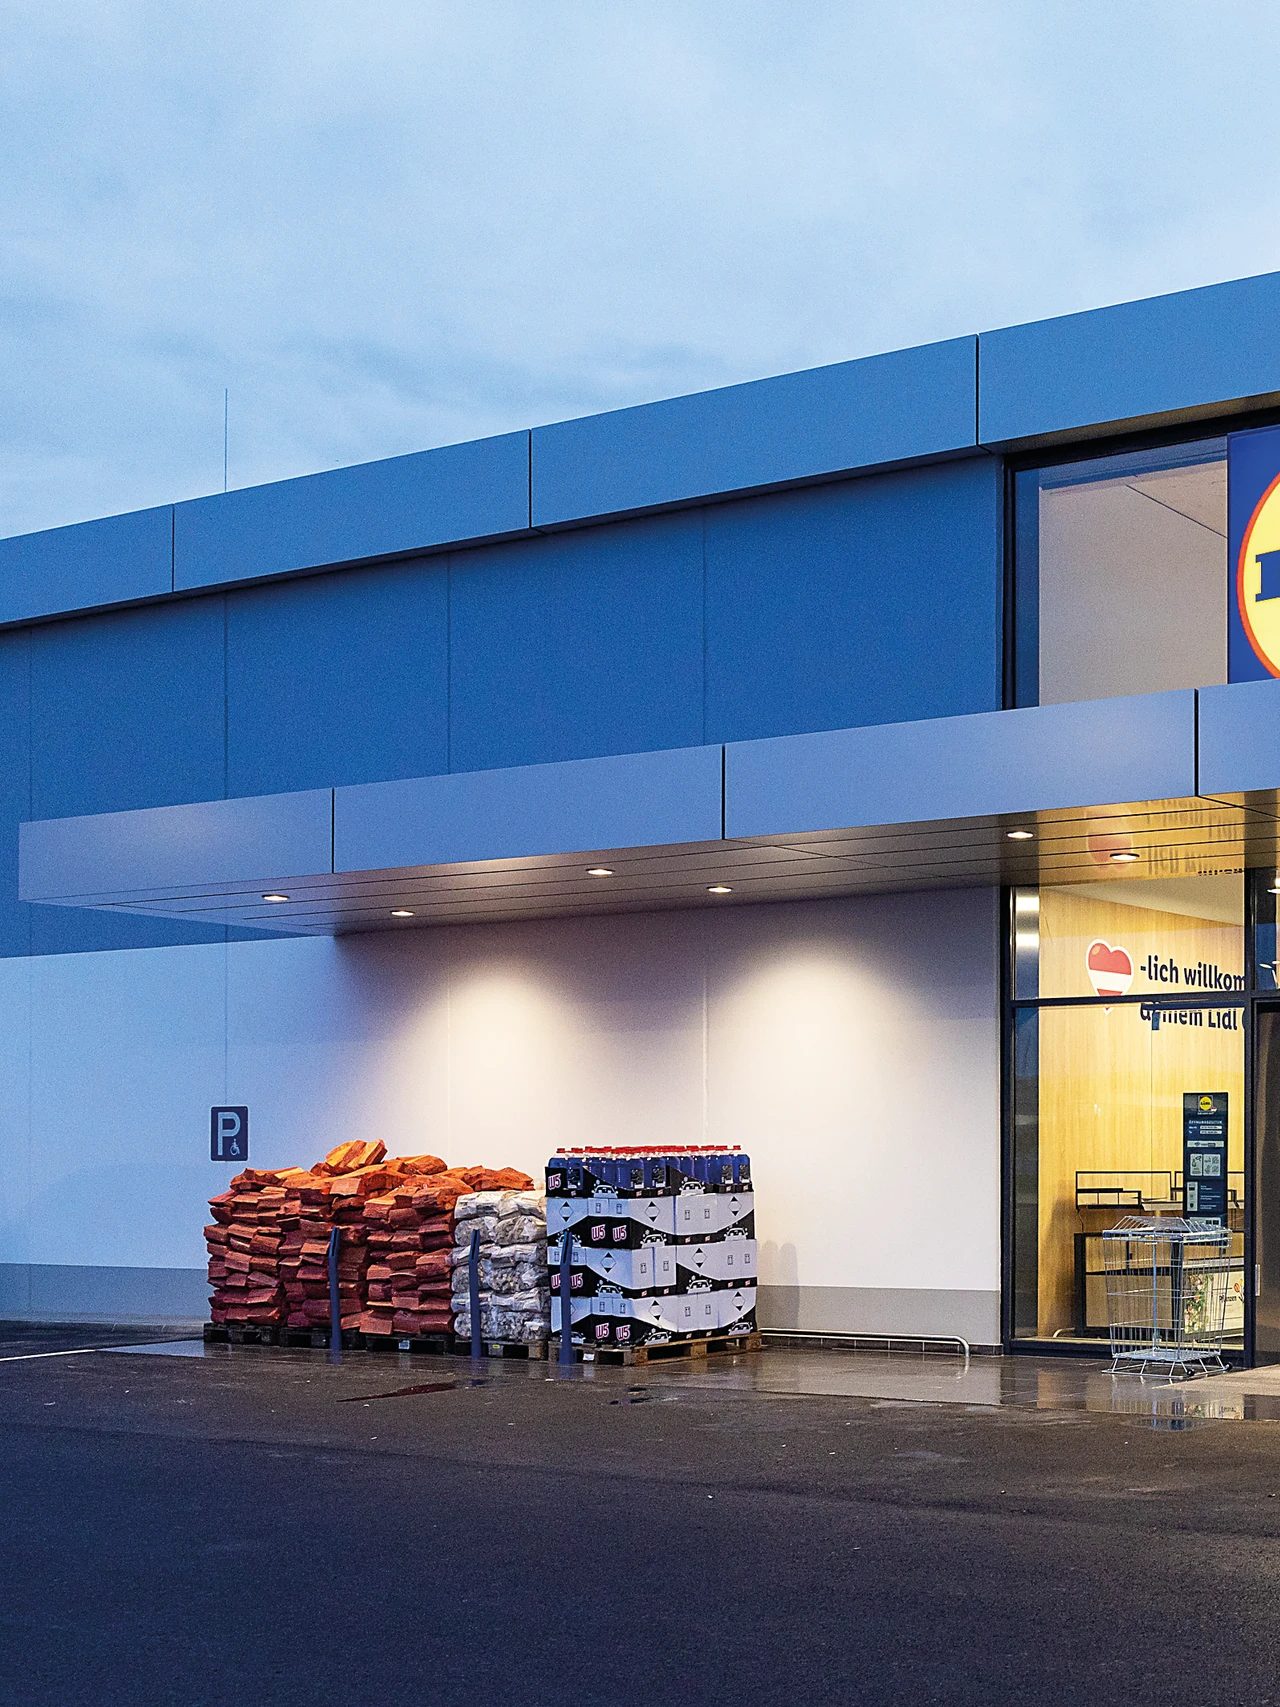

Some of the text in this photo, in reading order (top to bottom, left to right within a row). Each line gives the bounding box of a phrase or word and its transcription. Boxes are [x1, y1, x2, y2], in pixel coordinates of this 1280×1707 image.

[1140, 955, 1179, 984] -lich
[1184, 962, 1245, 991] willkom
[217, 1111, 241, 1156] P
[547, 1173, 561, 1190] W5
[591, 1223, 606, 1241] W5
[612, 1224, 627, 1242] W5
[595, 1322, 610, 1339] W5
[615, 1324, 631, 1341] W5
